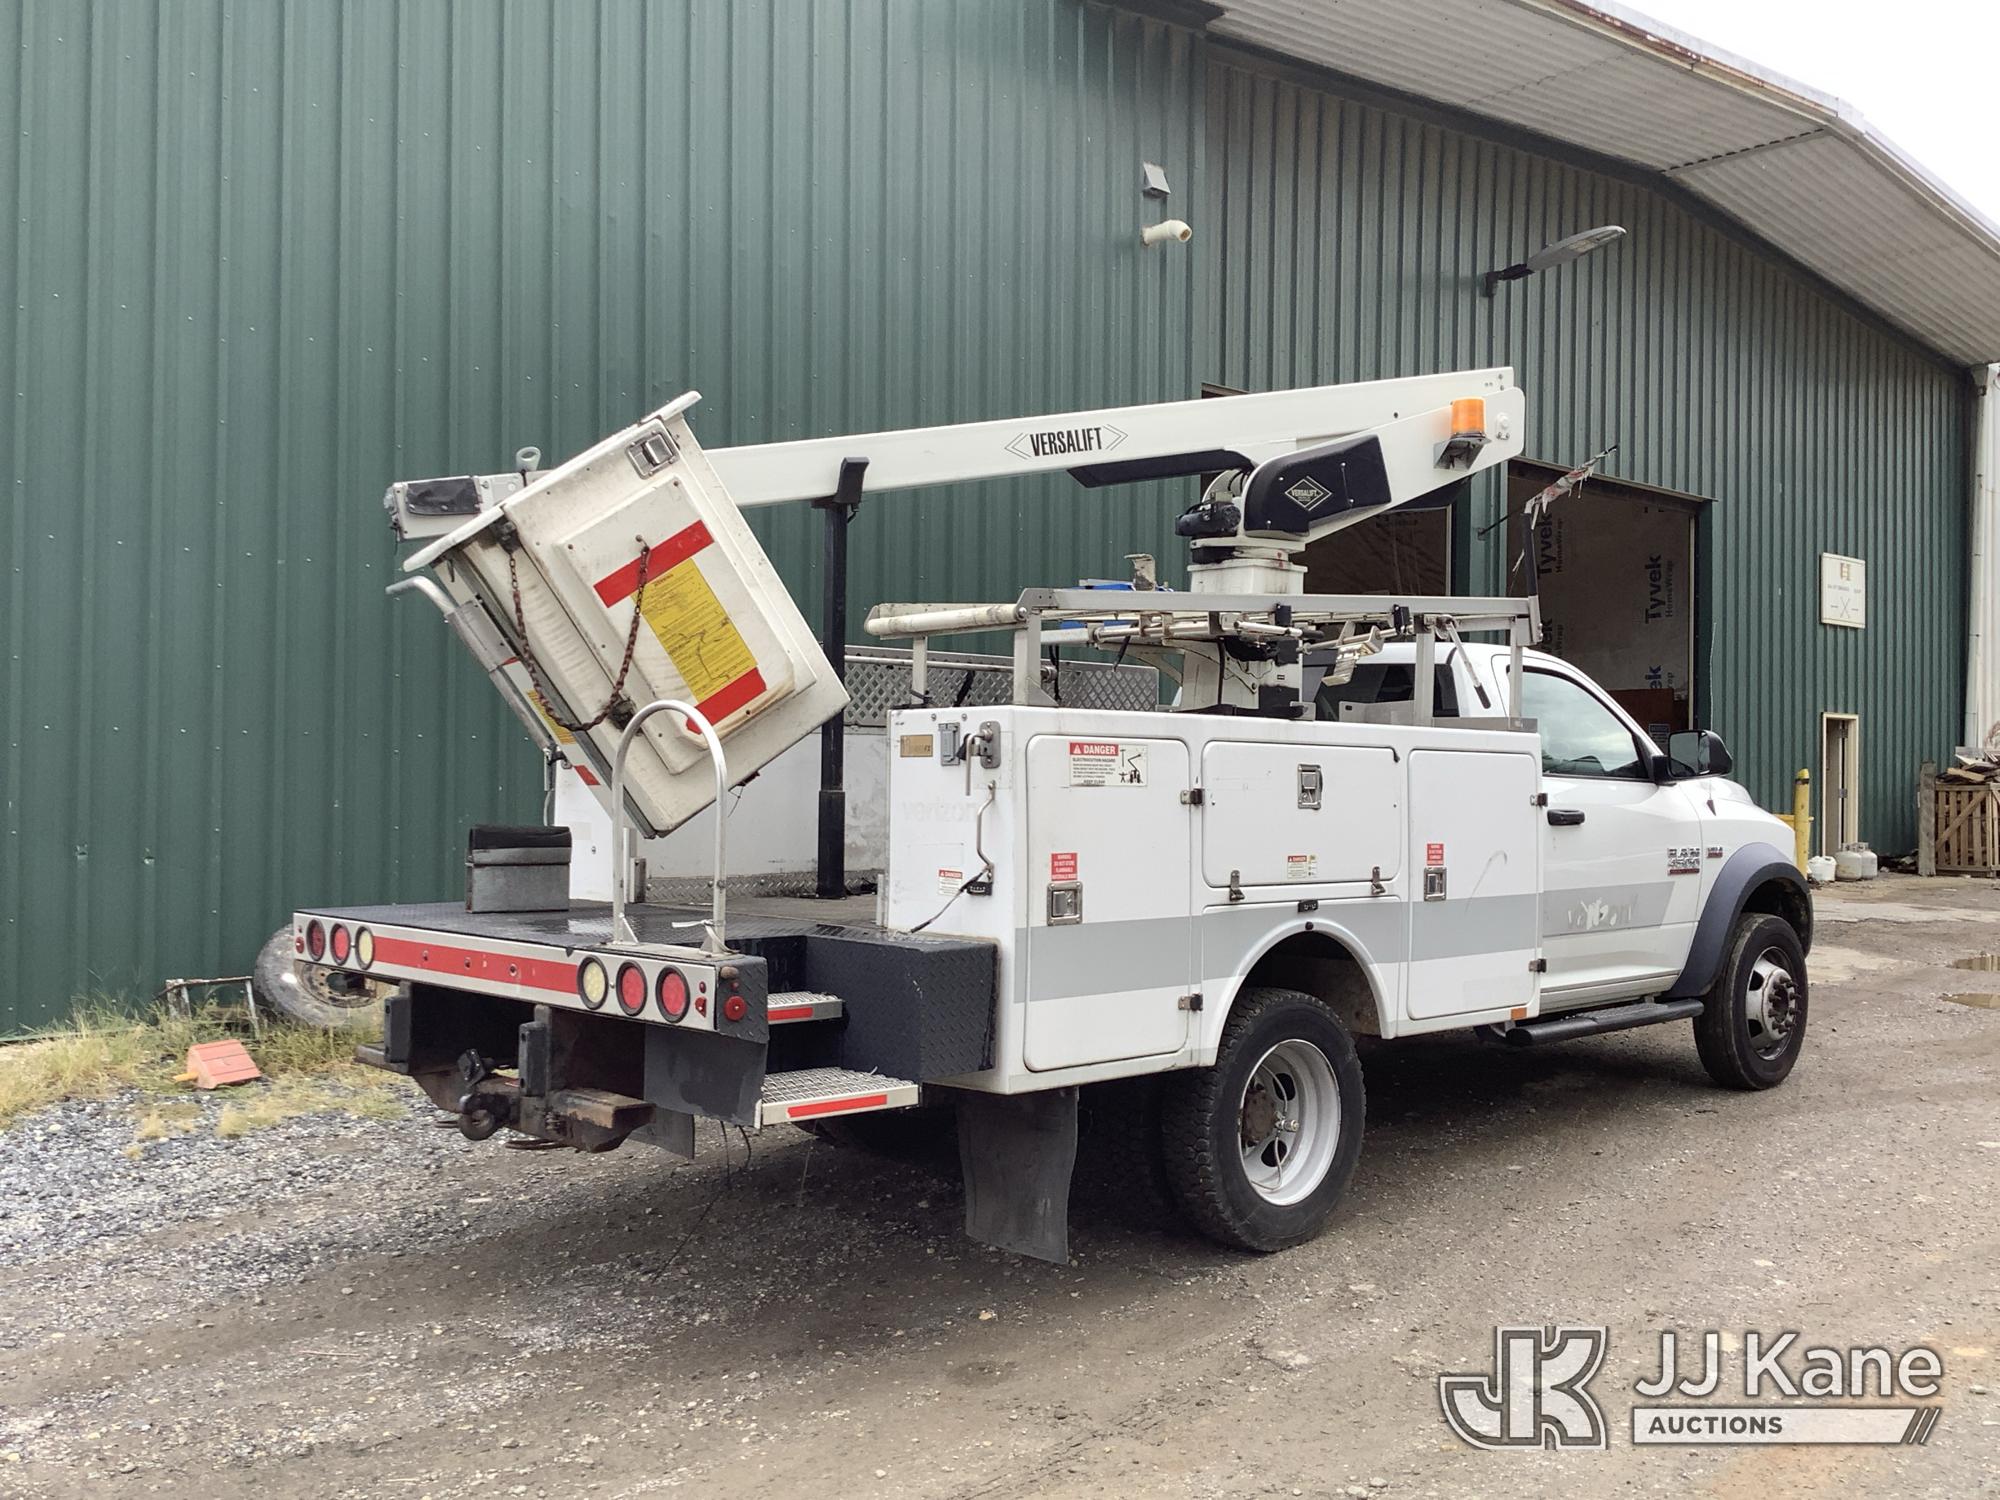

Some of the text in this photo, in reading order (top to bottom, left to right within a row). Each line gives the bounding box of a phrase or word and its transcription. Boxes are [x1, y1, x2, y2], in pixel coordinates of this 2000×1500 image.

[1030, 427, 1102, 457] VERSALIFT
[1645, 554, 1666, 624] Tyvek
[1665, 560, 1673, 617] HomeWrap
[1083, 745, 1116, 755] DANGER
